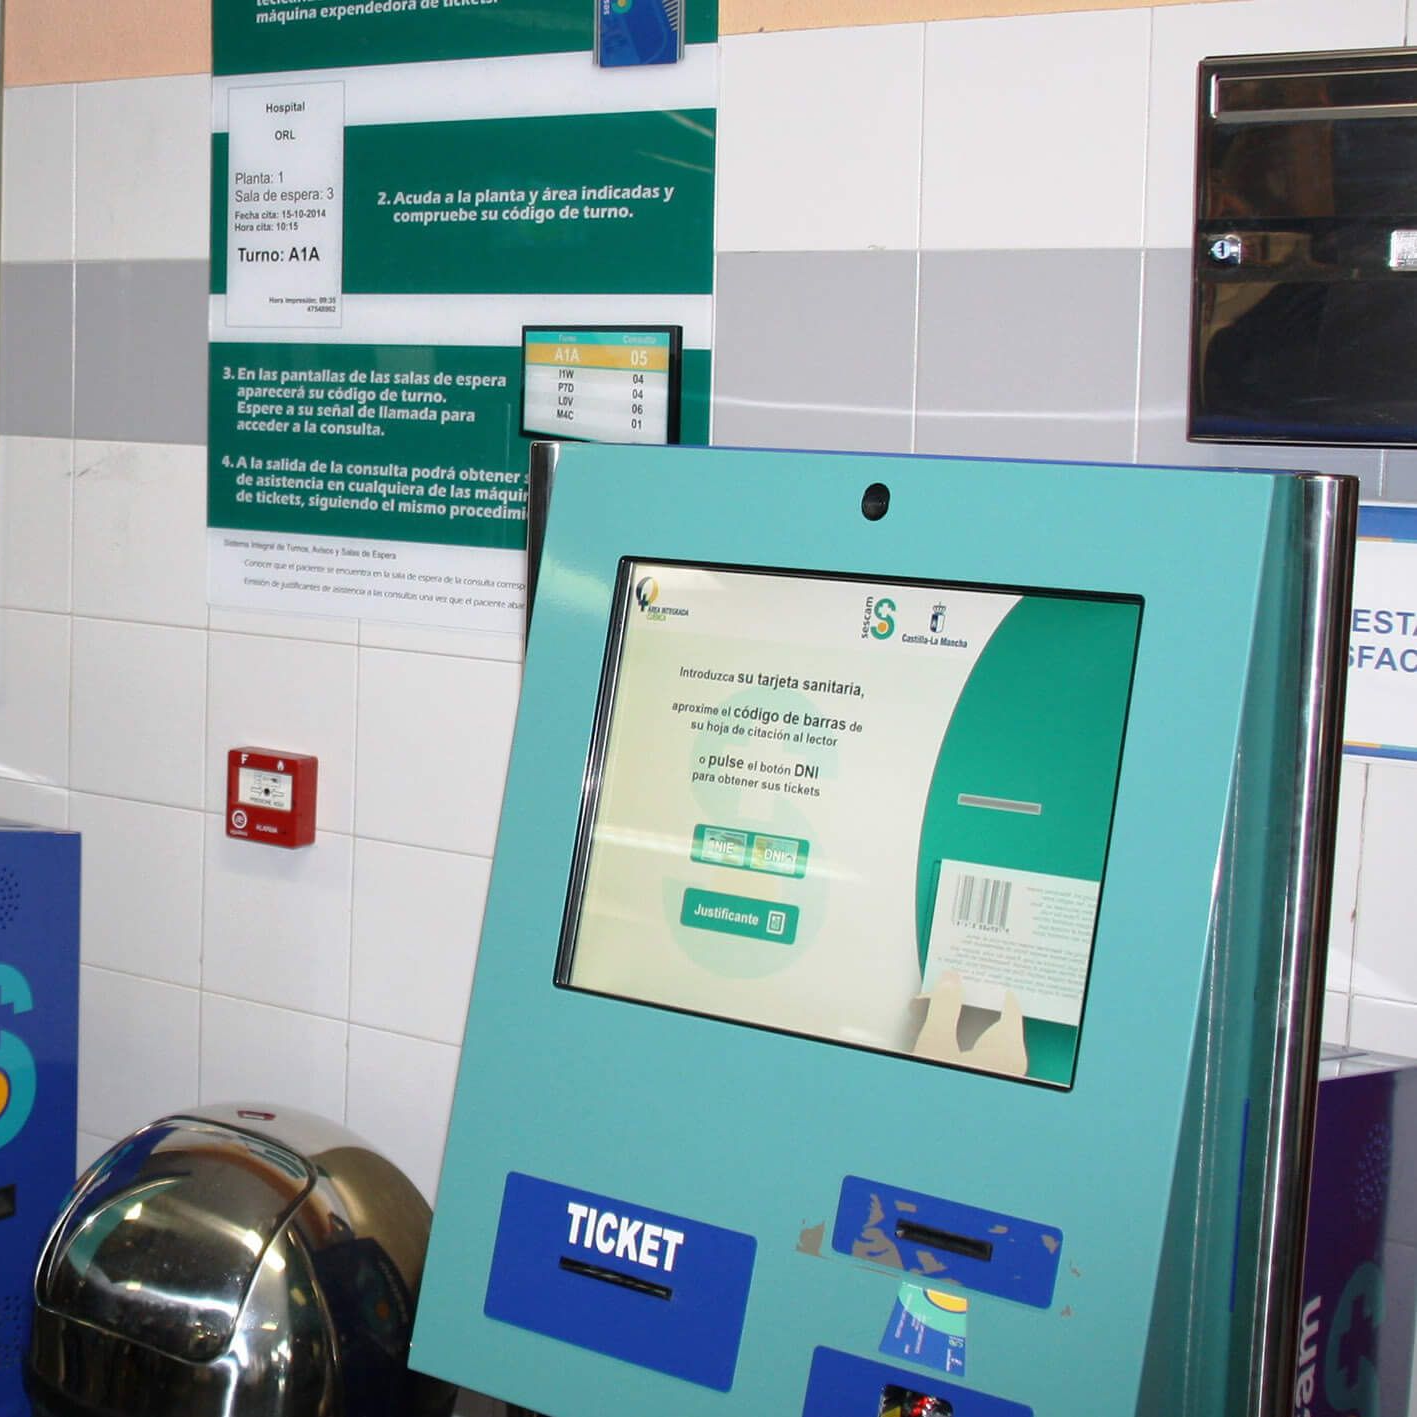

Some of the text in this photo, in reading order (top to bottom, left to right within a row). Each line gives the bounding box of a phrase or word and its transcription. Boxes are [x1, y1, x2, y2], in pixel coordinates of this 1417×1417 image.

[256, 7, 317, 25] máquina
[320, 1, 416, 20] expendedora
[420, 0, 439, 9] de
[266, 102, 305, 113] Hospital
[274, 130, 296, 141] ORL
[235, 171, 284, 185] Planta: 1
[235, 188, 335, 205] Sala de espera: 3
[377, 184, 675, 207] 2. Acuda a la planta y área indicadas y
[234, 209, 326, 220] Fecha cita: 15-10-2014
[393, 205, 634, 226] compruebe su código de turno.
[234, 221, 299, 232] Hora cita: 10:15
[238, 247, 320, 262] Turno: A1A
[554, 348, 648, 367] A1A 05
[222, 366, 507, 390] 3. En las pantallas de las salas de espera
[632, 374, 644, 385] 04
[237, 385, 447, 404] aparecerá su código de turno.
[558, 383, 644, 400] P7D 04
[237, 401, 475, 425] Espere a su señal de llamada para
[556, 409, 642, 429] M4C 01
[631, 404, 644, 415] 06
[236, 419, 385, 437] acceder a la consulta.
[222, 455, 234, 468] 4.
[235, 456, 248, 468] A
[250, 456, 263, 470] la
[265, 457, 306, 472] salida
[309, 460, 327, 473] de
[330, 460, 343, 474] la
[346, 462, 408, 478] consulta
[411, 466, 456, 482] podrá
[459, 467, 520, 484] obtener
[236, 473, 253, 485] de
[256, 474, 324, 490] asistencia
[327, 481, 345, 491] en
[348, 480, 424, 498] cualquiera
[428, 483, 446, 498] de
[450, 484, 470, 499] las
[236, 489, 253, 502] de
[256, 490, 305, 508] tickets,
[308, 494, 378, 511] siguiendo
[381, 498, 395, 512] el
[398, 500, 446, 515] mismo
[251, 541, 275, 552] Integral
[372, 550, 397, 561] Espera
[244, 558, 495, 587] Conocer paciente espera consulta
[244, 577, 270, 587] Emisión
[332, 585, 366, 595] asistencia
[384, 590, 418, 600] consultas
[473, 598, 506, 609] paciente
[861, 596, 874, 639] sescam
[1351, 608, 1417, 637] EST
[901, 633, 968, 649] Castilla-La Mancha
[679, 666, 865, 698] Introduzca su tarjeta sanitaria,
[672, 702, 863, 733] aproxime el código de barras de
[690, 721, 838, 747] su hoja de citación al lector
[698, 753, 820, 780] o pulse el botón DNI
[692, 771, 821, 798] para obtener sus tickets
[693, 903, 759, 926] Justificante
[567, 1202, 685, 1272] TICKET
